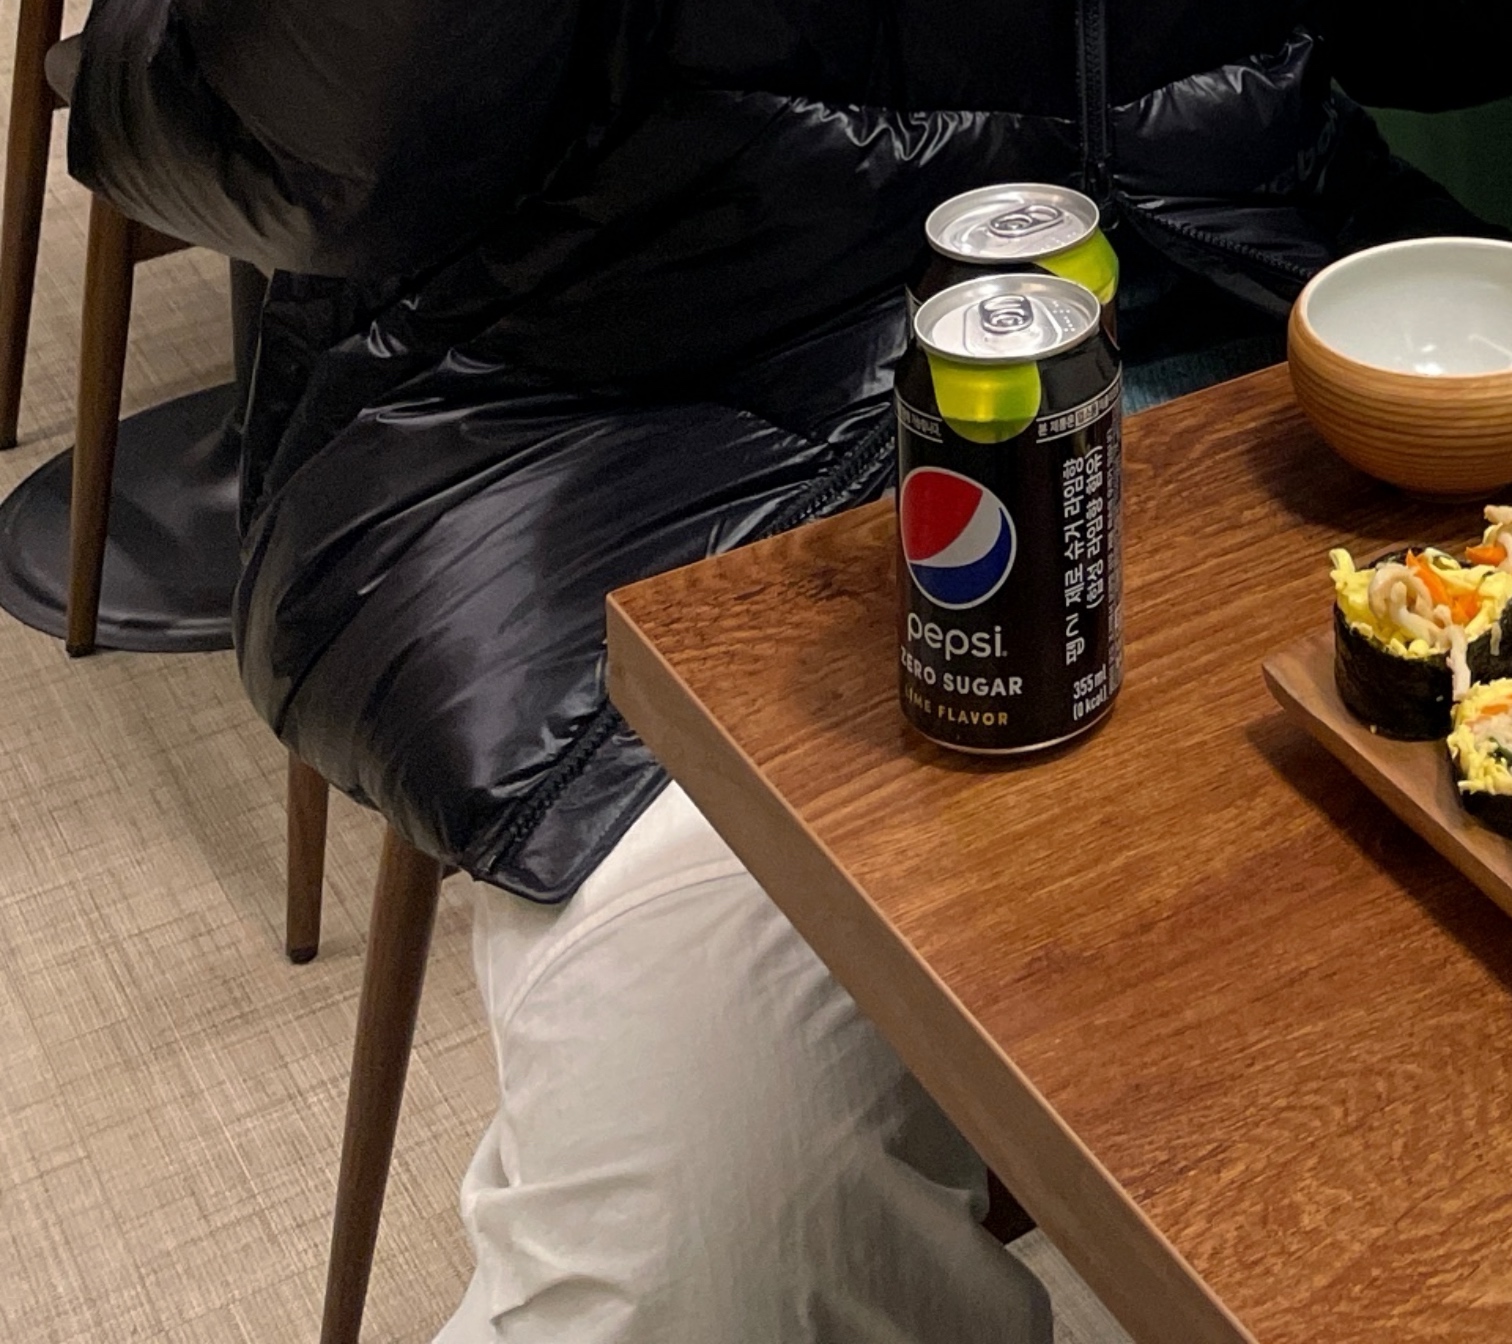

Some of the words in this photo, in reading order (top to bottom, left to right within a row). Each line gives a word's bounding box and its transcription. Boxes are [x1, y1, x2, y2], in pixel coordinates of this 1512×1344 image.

[1063, 457, 1085, 518] 라임향
[1064, 519, 1085, 560] 슈거
[1086, 496, 1103, 559] 라임향
[1064, 563, 1084, 607] 제로
[907, 612, 1002, 661] pepsi
[1065, 613, 1085, 665] 펩시
[901, 645, 936, 685] ZERO
[942, 672, 1023, 696] SUGAR
[938, 705, 1008, 726] FLAVOR
